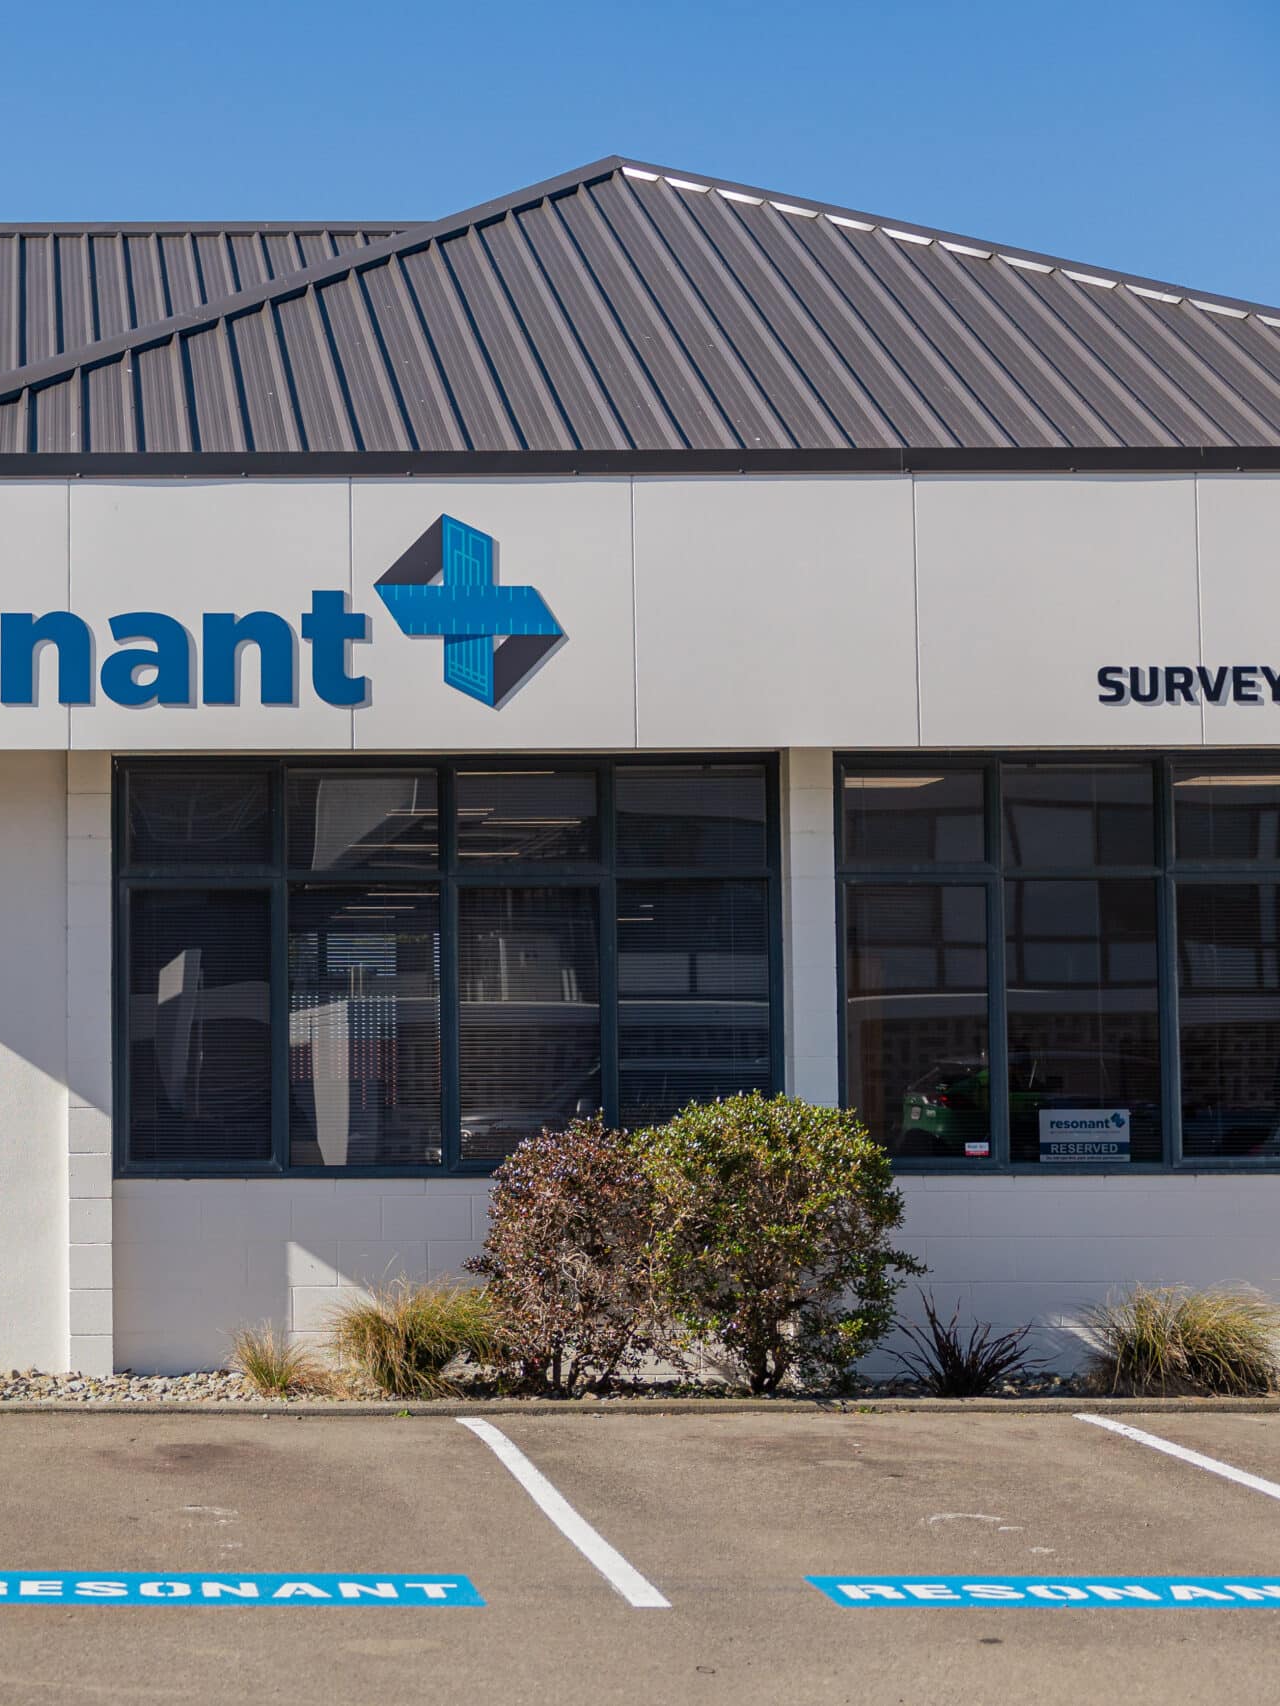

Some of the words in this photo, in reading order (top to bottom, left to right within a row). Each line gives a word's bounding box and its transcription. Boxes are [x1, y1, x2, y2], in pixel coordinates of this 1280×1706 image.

[1050, 1118, 1110, 1129] resonant
[1050, 1143, 1119, 1154] RESERVED
[836, 1584, 1280, 1602] RESONAN
